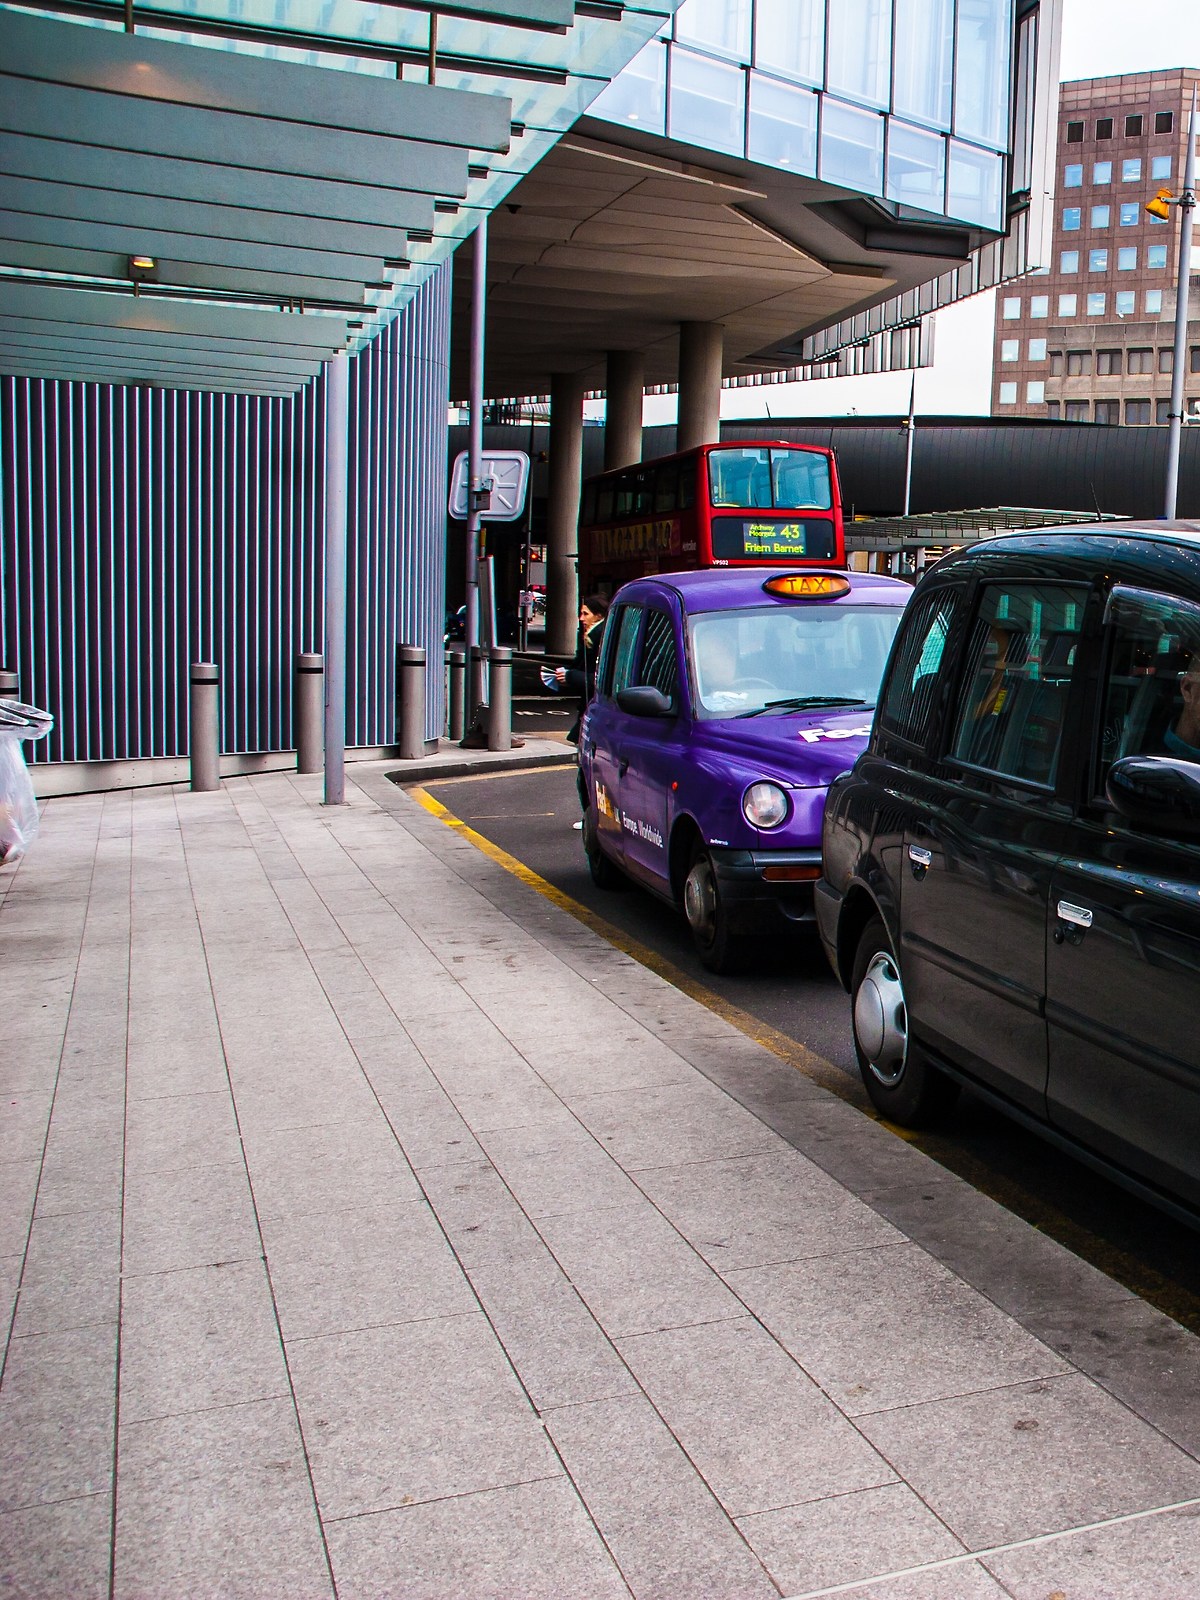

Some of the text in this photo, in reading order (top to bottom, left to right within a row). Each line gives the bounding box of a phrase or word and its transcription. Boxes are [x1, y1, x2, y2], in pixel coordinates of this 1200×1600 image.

[780, 524, 800, 539] 43
[745, 542, 804, 553] Friern Barnet
[786, 578, 834, 592] TAXI
